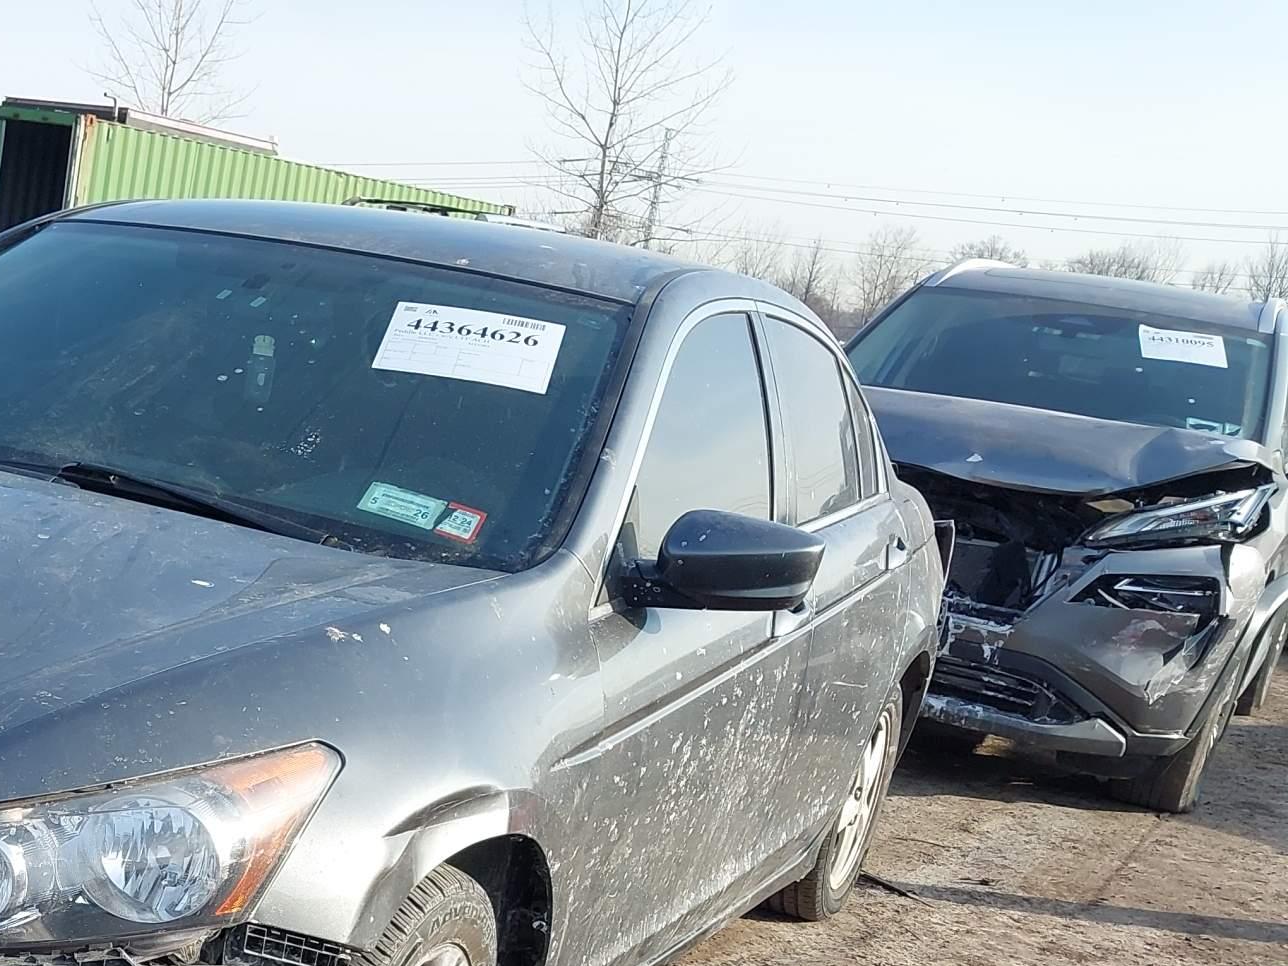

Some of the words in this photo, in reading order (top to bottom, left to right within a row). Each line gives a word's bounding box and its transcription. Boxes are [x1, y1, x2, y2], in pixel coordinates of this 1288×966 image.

[406, 317, 541, 347] 44364626
[370, 496, 378, 505] 5
[413, 508, 430, 520] 26
